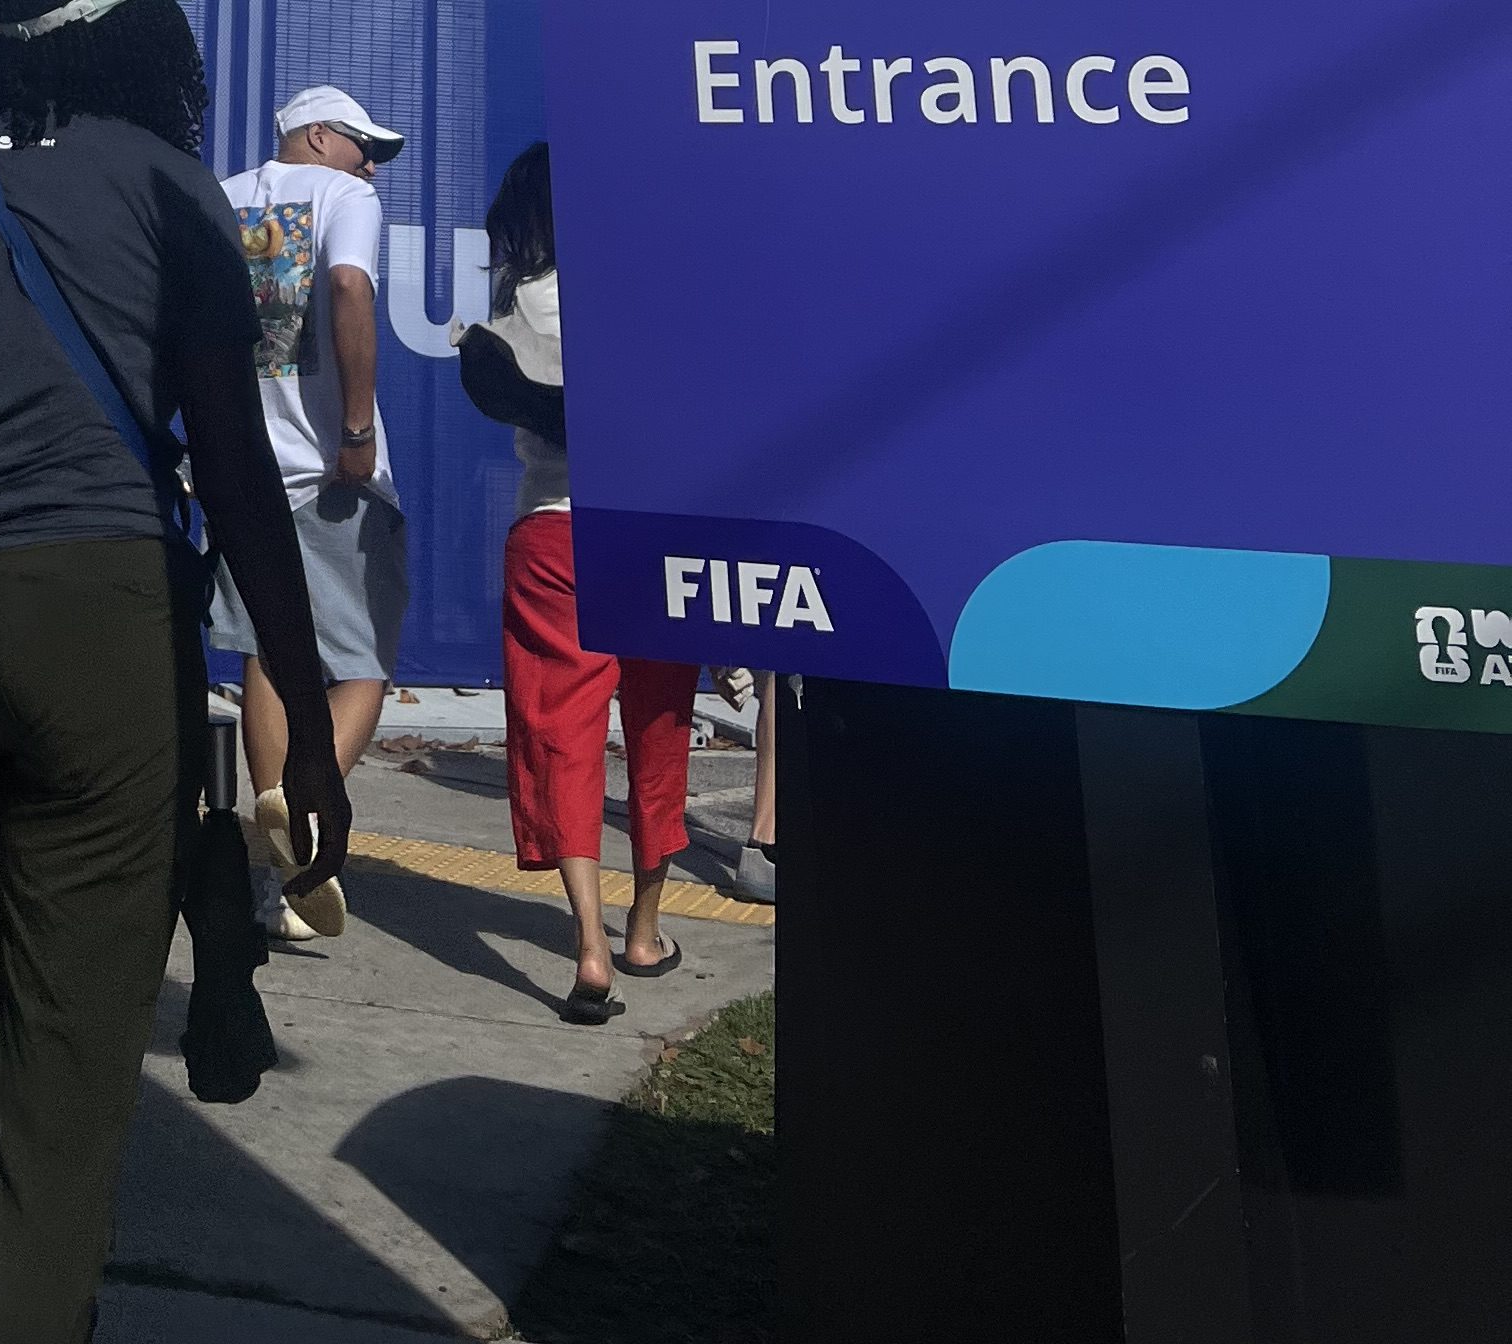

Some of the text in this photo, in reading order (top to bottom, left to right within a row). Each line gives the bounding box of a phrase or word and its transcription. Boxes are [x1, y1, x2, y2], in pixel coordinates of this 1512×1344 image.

[693, 39, 1191, 125] Entrance
[663, 556, 835, 633] FIFA
[1435, 666, 1458, 676] FIFA
